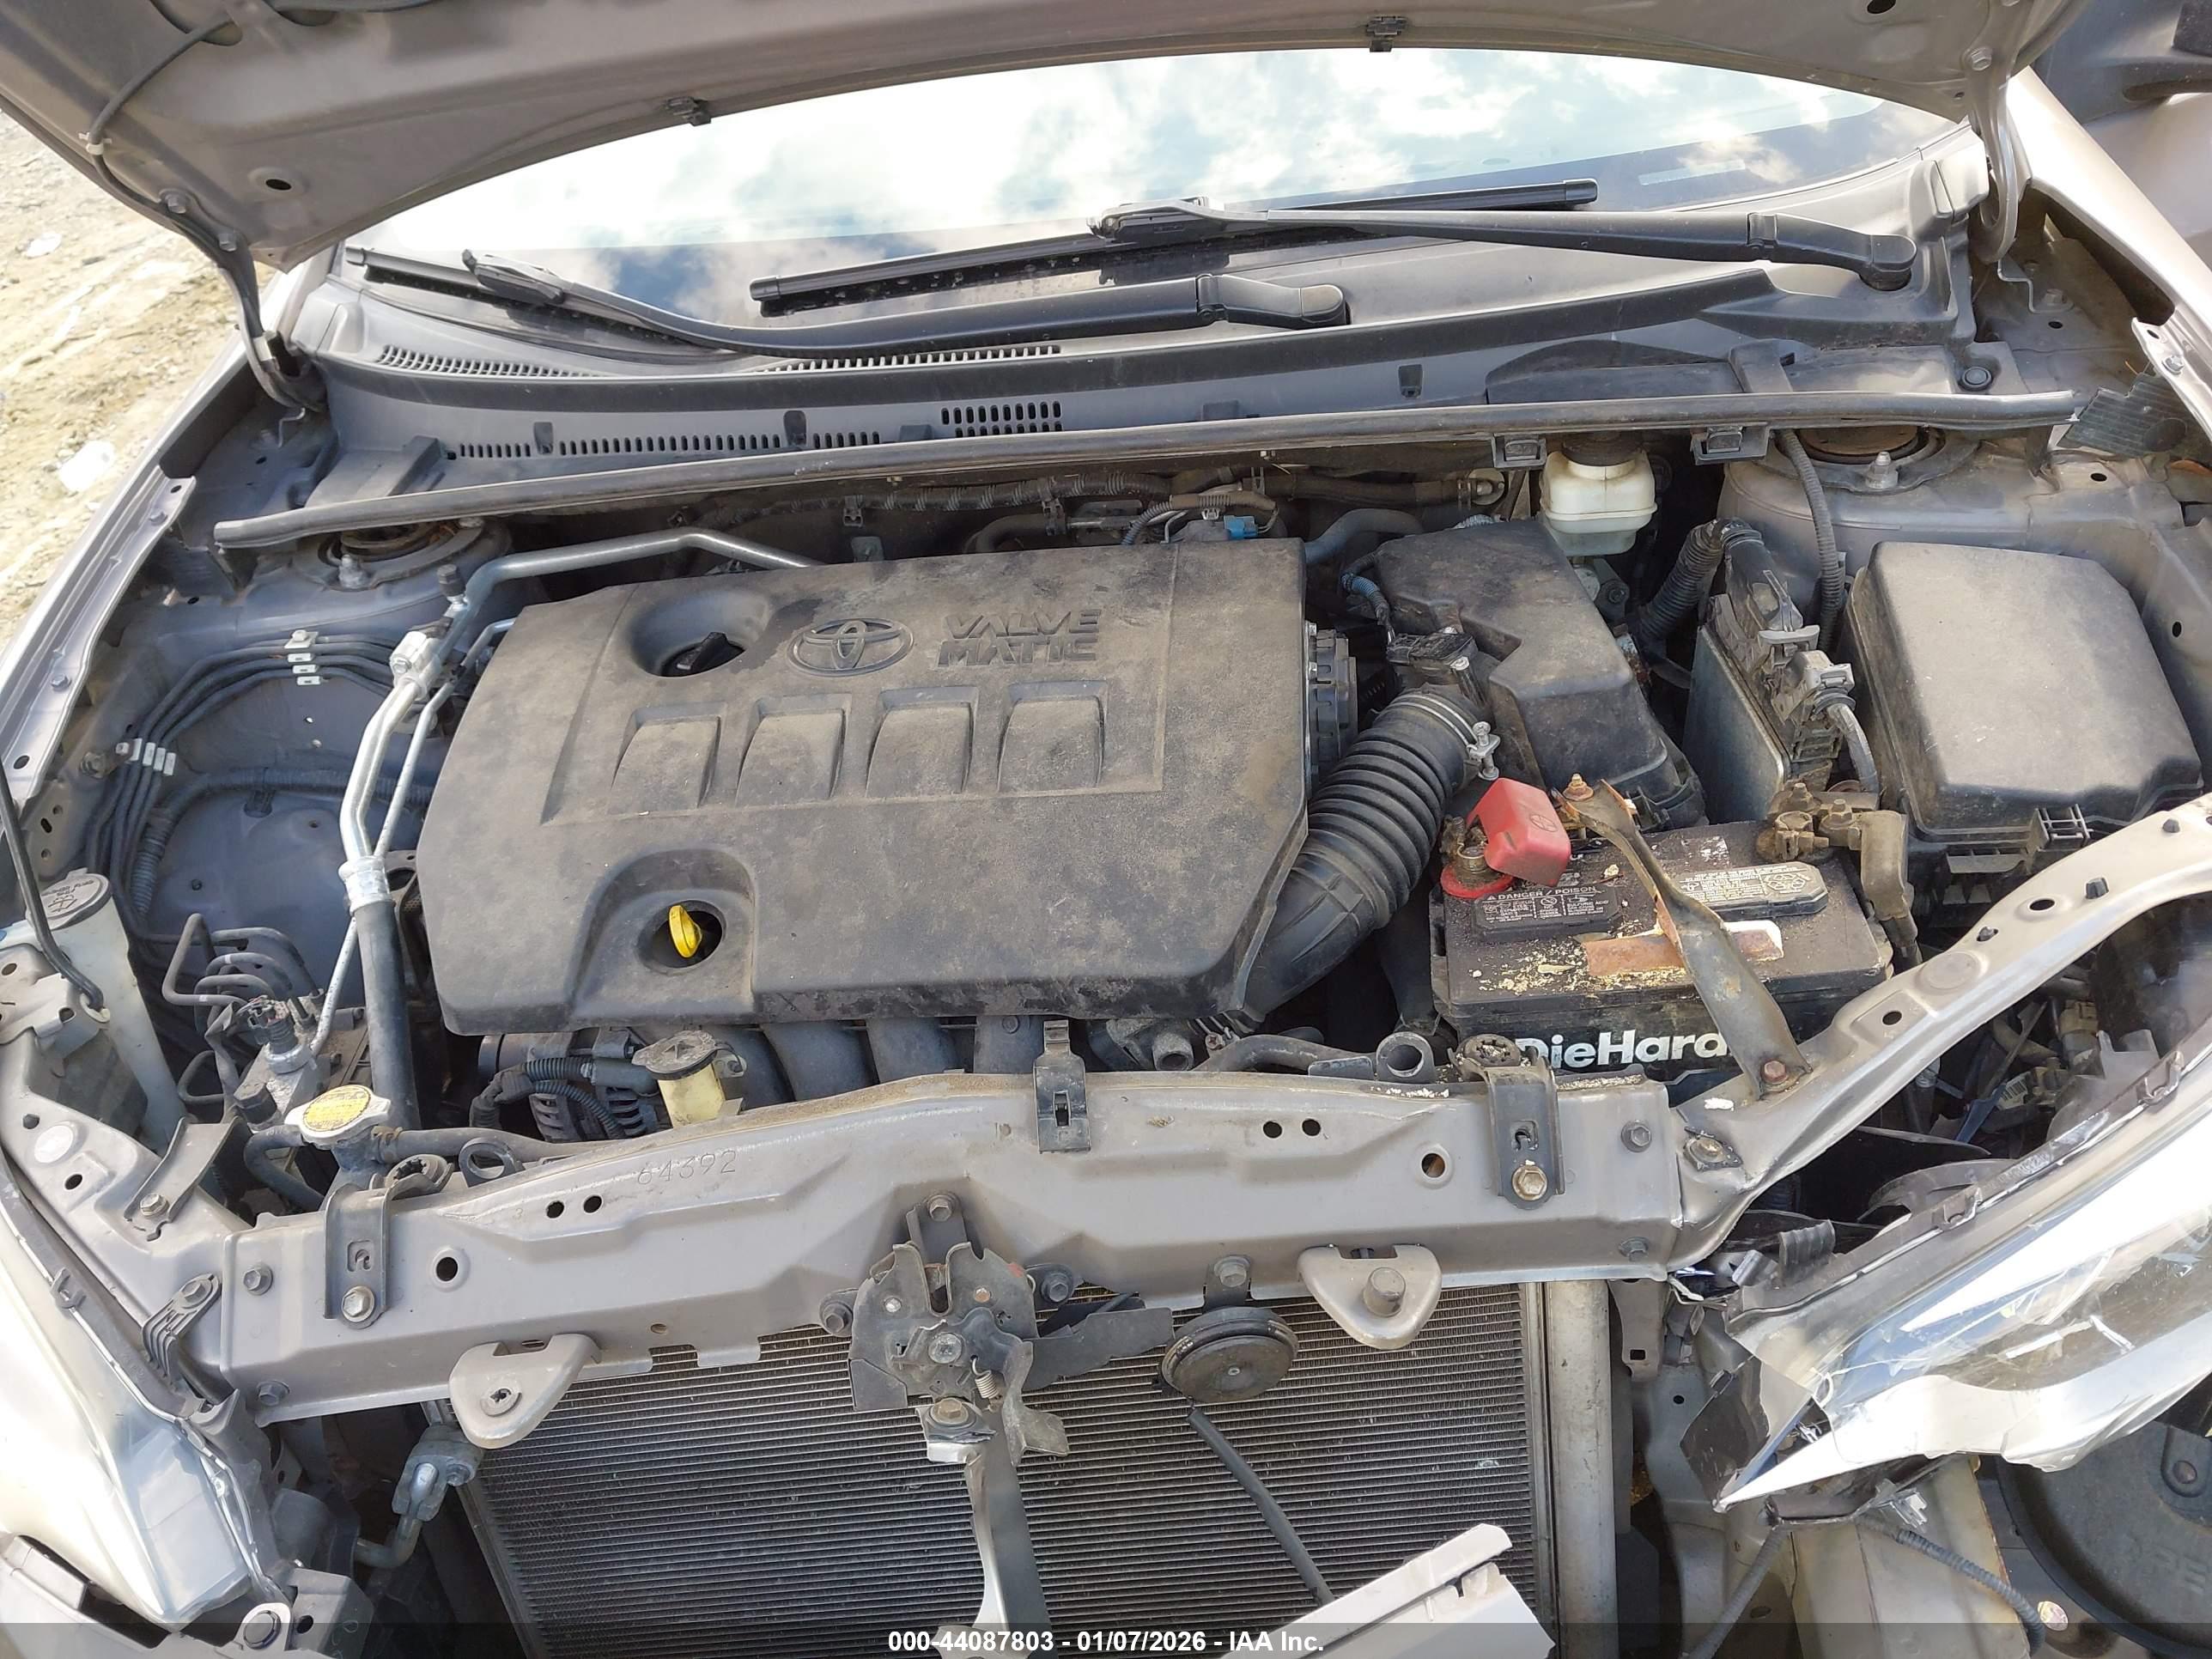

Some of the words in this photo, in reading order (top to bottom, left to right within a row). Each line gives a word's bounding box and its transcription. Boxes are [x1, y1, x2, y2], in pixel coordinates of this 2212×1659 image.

[945, 610, 1101, 639] VALVE
[939, 634, 1097, 667] MATIC
[1498, 890, 1543, 900] DANGER
[1555, 886, 1596, 895] POISON
